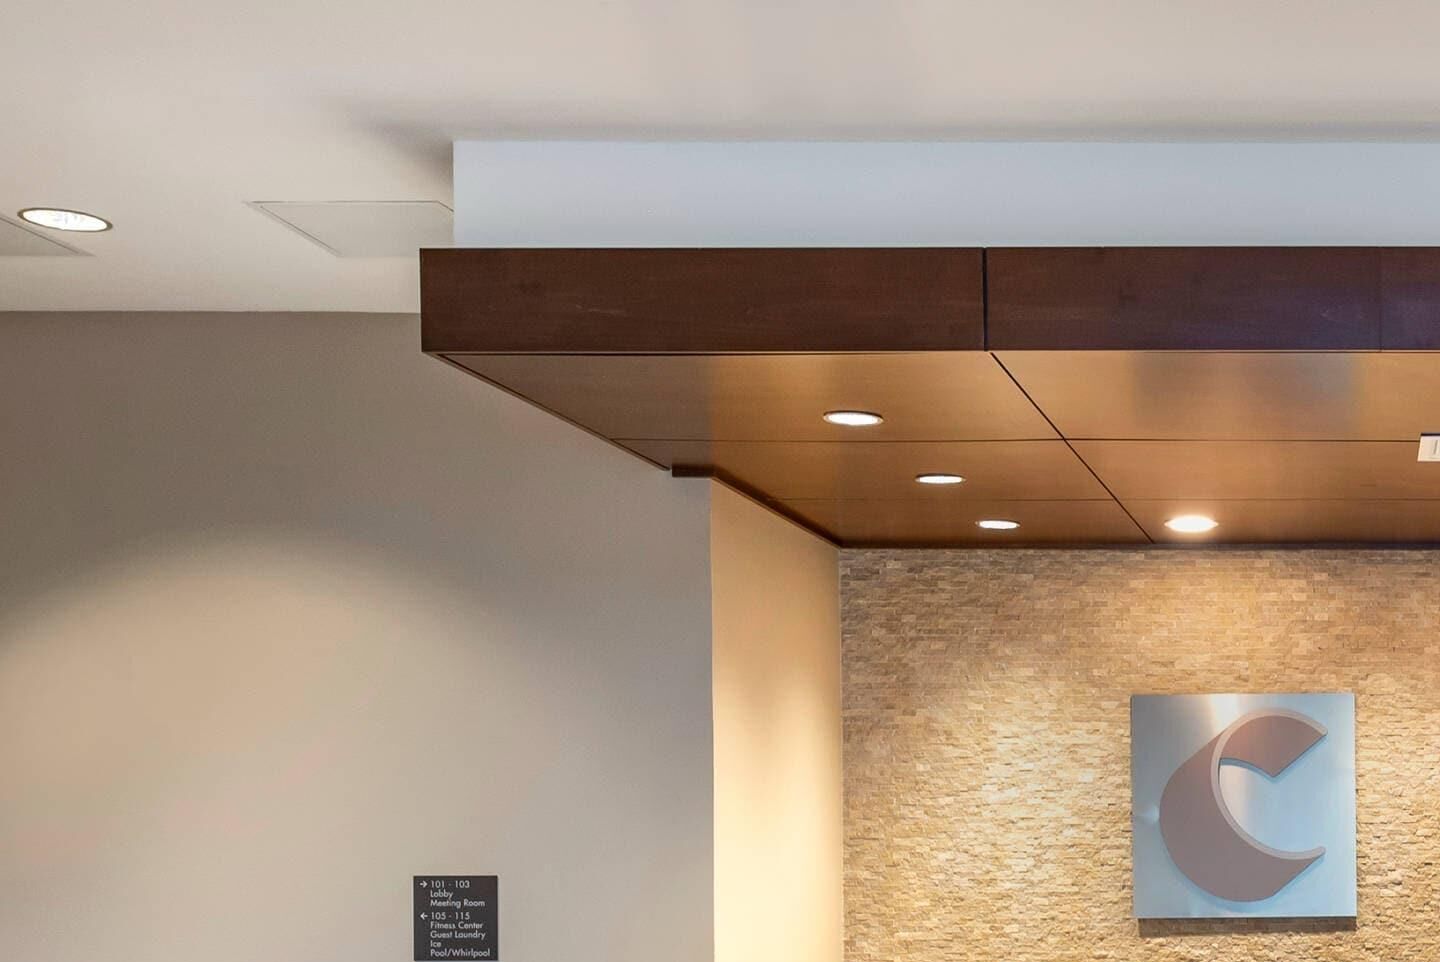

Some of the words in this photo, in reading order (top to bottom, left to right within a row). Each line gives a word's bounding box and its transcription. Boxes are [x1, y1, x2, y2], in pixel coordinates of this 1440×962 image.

[431, 880, 445, 888] 101
[455, 880, 470, 888] 103
[430, 889, 453, 900] Lobby
[430, 899, 461, 909] Meeting
[463, 899, 486, 907] Room
[431, 912, 446, 920] 105
[455, 912, 470, 920] 115
[430, 921, 456, 929] Fitness
[458, 921, 484, 929] Center
[430, 930, 453, 939] Guest
[454, 930, 486, 940] Laundry
[430, 940, 442, 948] Ice
[430, 948, 491, 958] Pool/Whirlpool
